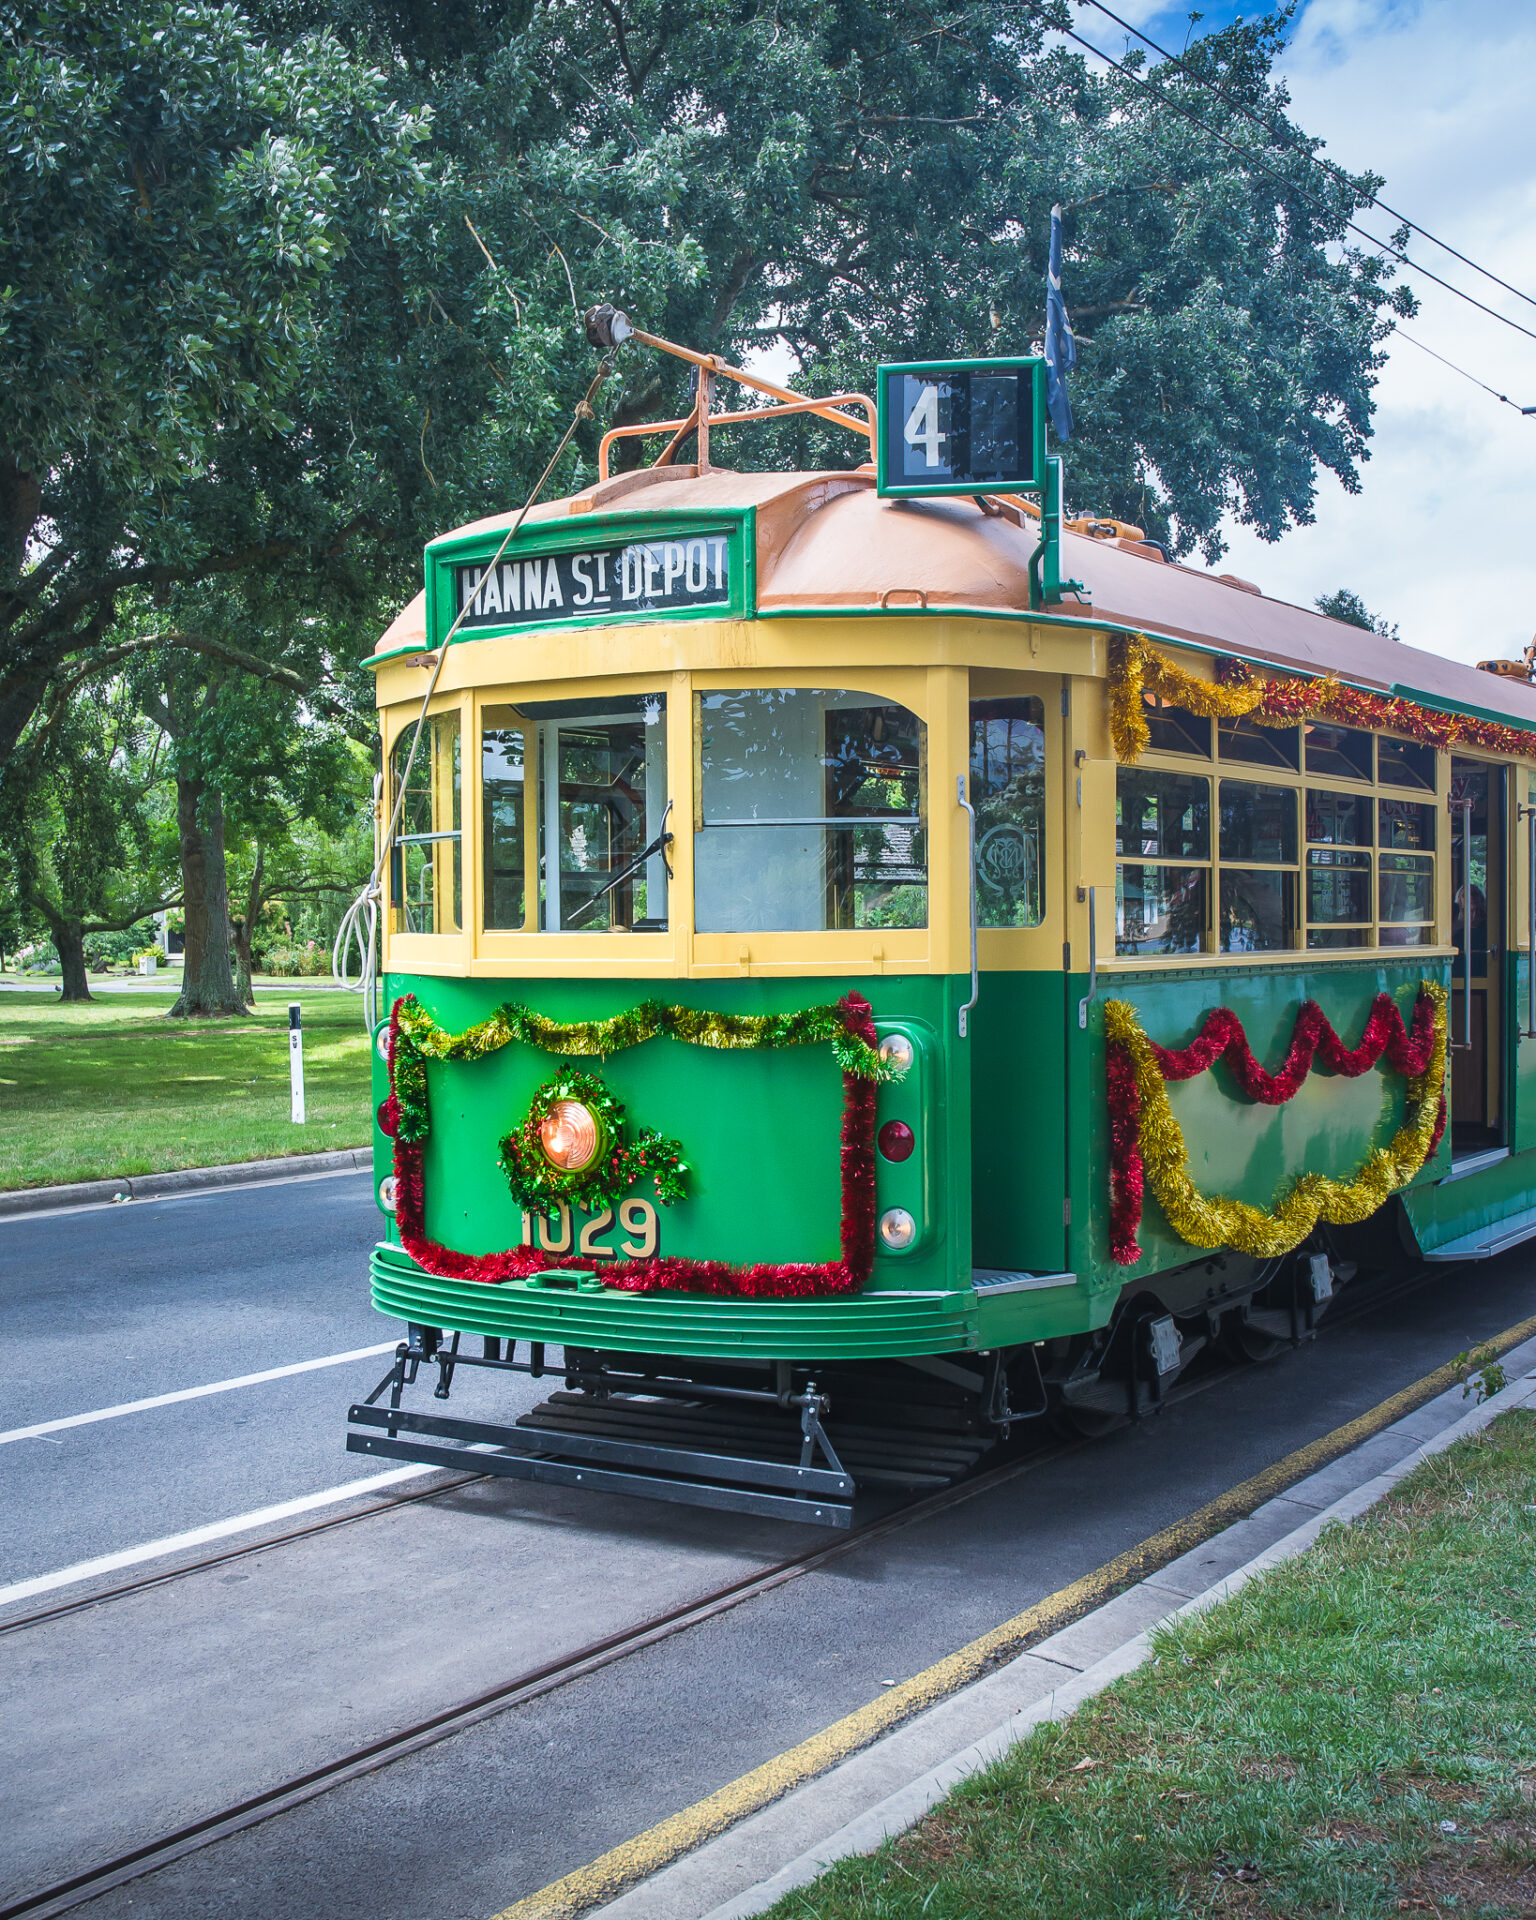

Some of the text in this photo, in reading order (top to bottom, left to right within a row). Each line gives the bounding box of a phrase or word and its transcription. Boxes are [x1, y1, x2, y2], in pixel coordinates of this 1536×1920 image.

[904, 386, 945, 467] 4
[463, 558, 564, 617] HANNA
[622, 537, 728, 601] DEPOT
[521, 1197, 658, 1259] 1029
